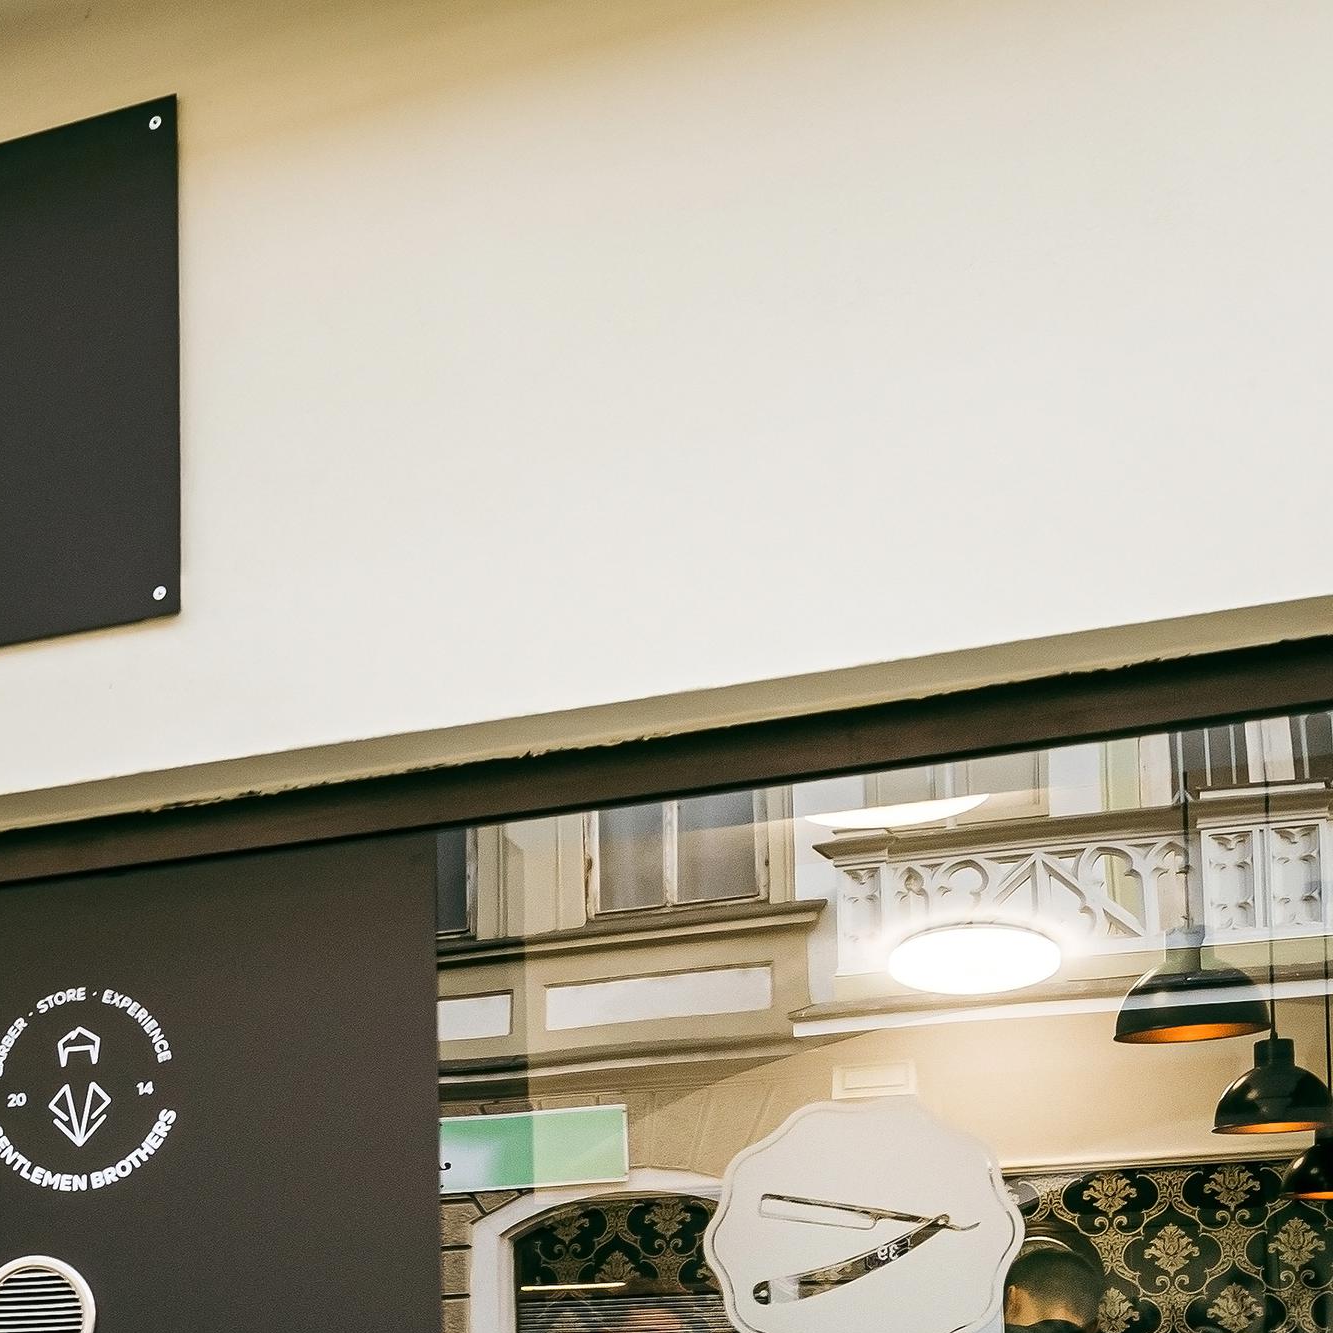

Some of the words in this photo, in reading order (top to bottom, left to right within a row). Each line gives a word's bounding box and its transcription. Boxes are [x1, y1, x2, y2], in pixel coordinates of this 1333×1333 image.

[36, 986, 87, 1014] STORE
[101, 988, 173, 1064] EXPERIENCE
[7, 1092, 27, 1108] 20
[135, 1080, 155, 1096] 14
[89, 1108, 177, 1190] BROTHERS
